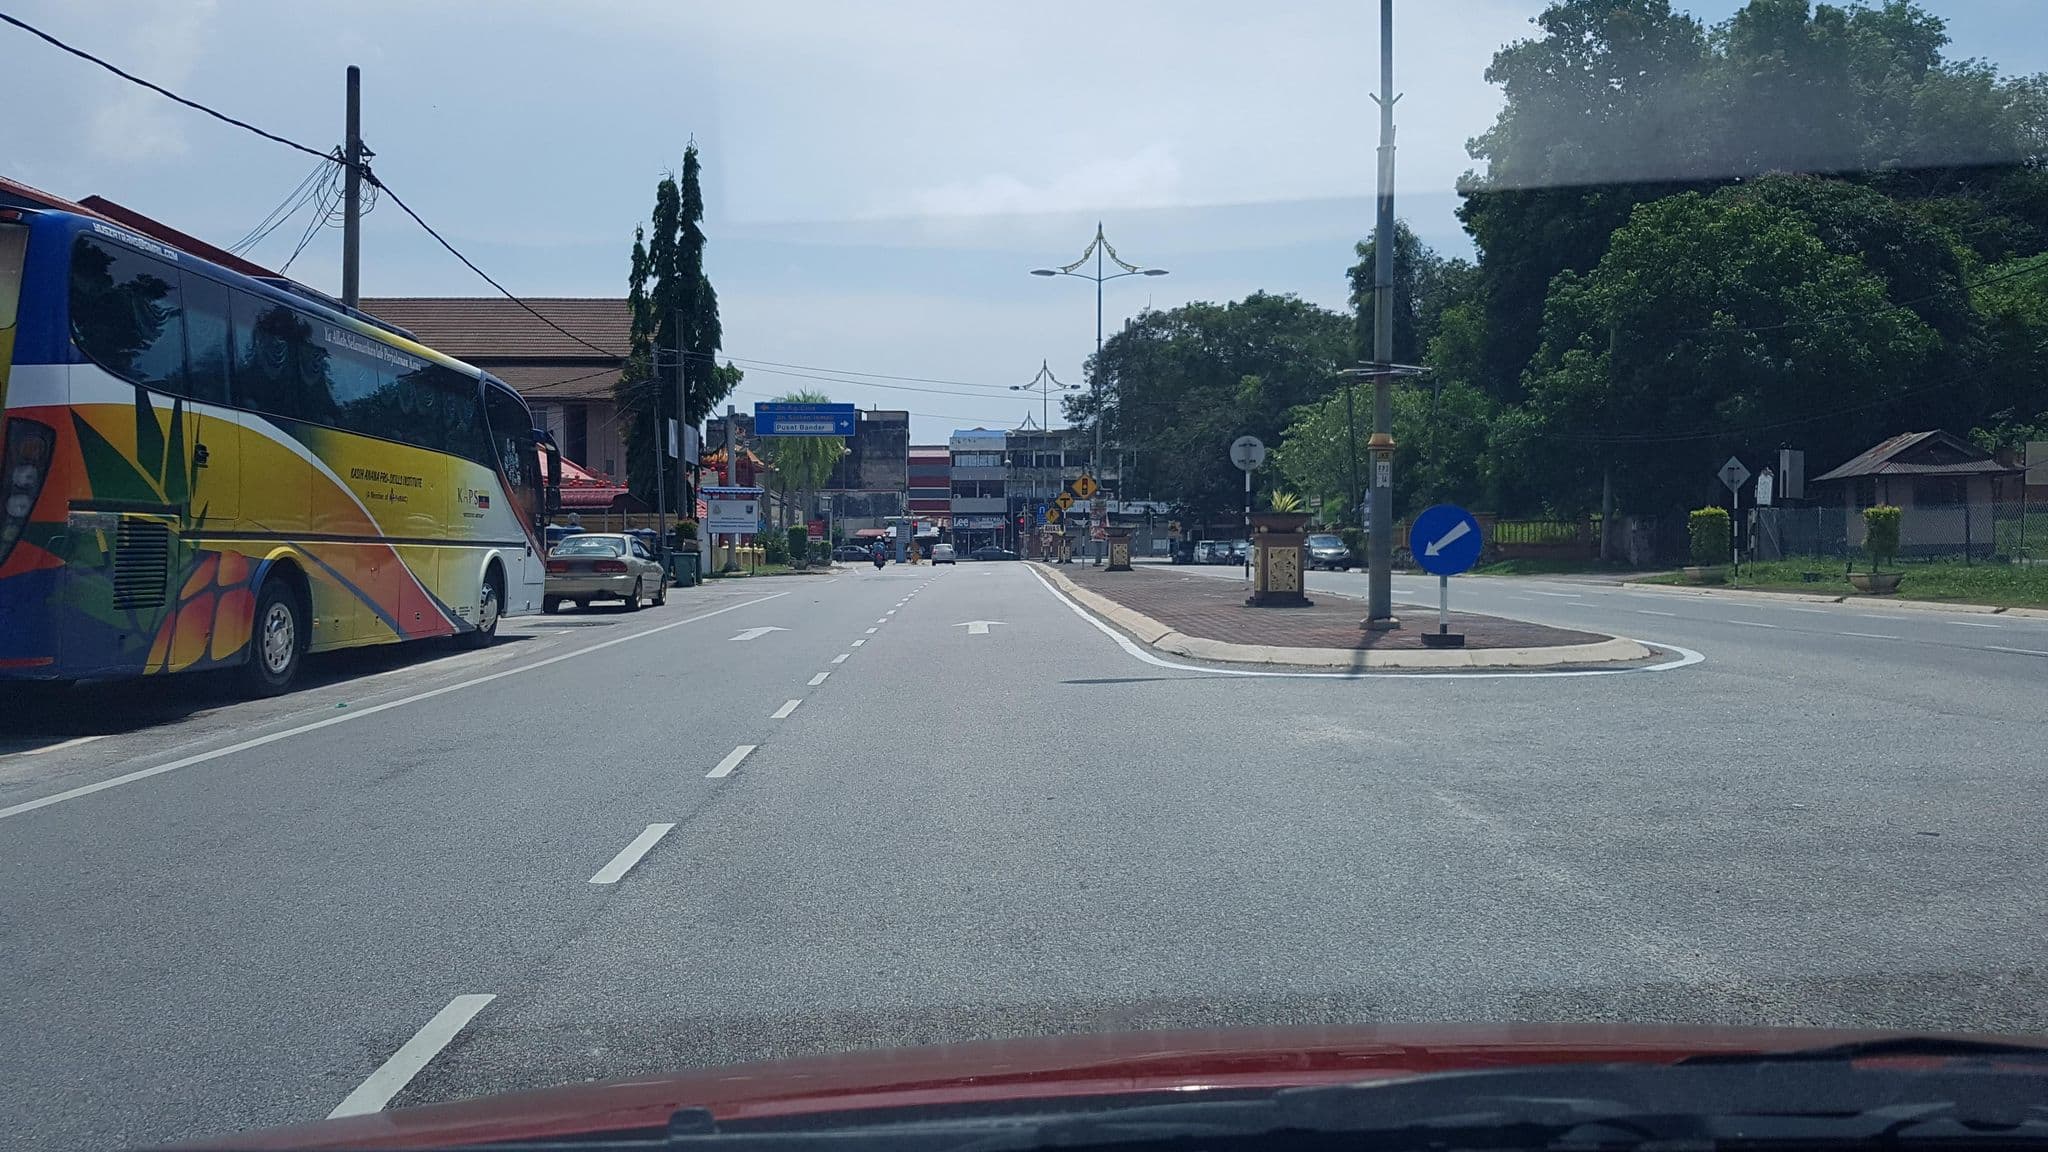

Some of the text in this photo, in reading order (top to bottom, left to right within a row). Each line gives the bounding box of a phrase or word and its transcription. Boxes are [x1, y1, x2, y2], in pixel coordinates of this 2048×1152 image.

[776, 423, 825, 431] Pusat Bandar
[953, 517, 969, 527] Lee
